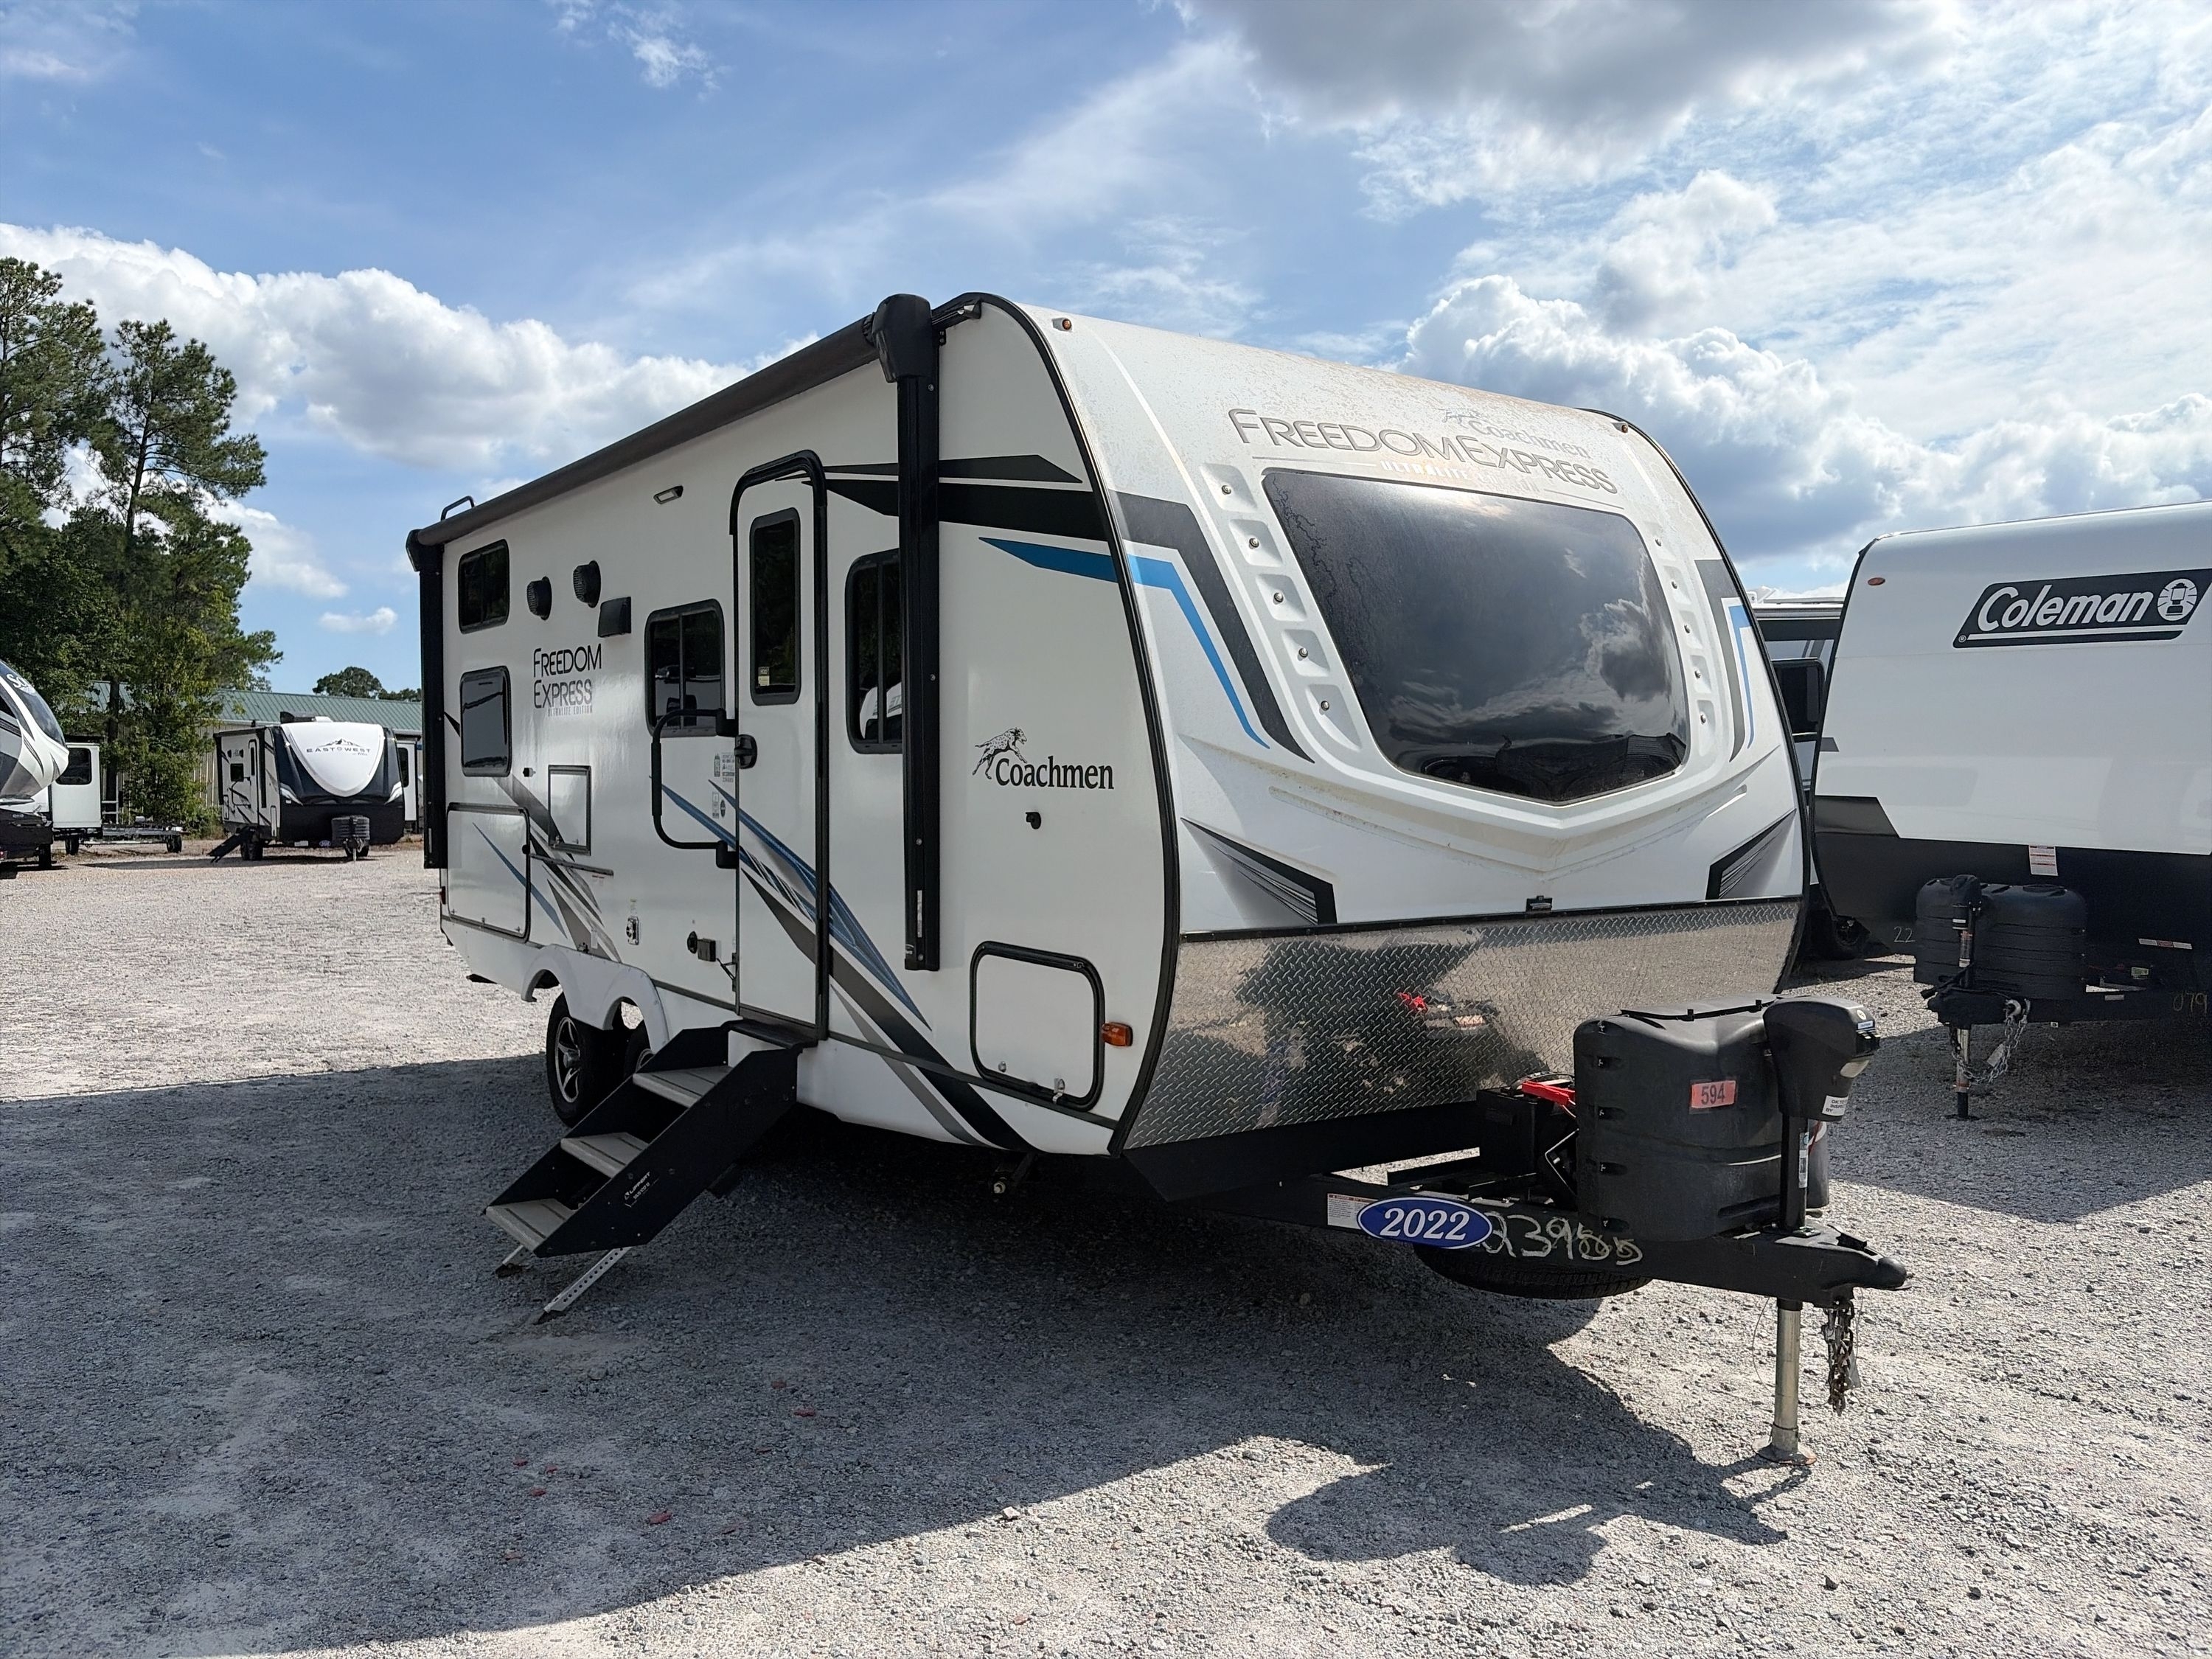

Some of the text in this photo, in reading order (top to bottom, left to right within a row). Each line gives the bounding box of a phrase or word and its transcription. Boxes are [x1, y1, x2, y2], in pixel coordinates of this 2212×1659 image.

[1468, 420, 1591, 459] Coachmen
[1978, 585, 2154, 632] Coleman
[533, 643, 602, 678] FREEDOM
[534, 678, 593, 709] EXPRESS
[995, 756, 1115, 789] Coachmen
[1893, 926, 1916, 943] 22
[1701, 1083, 1725, 1105] 594
[1380, 1208, 1470, 1241] 2022
